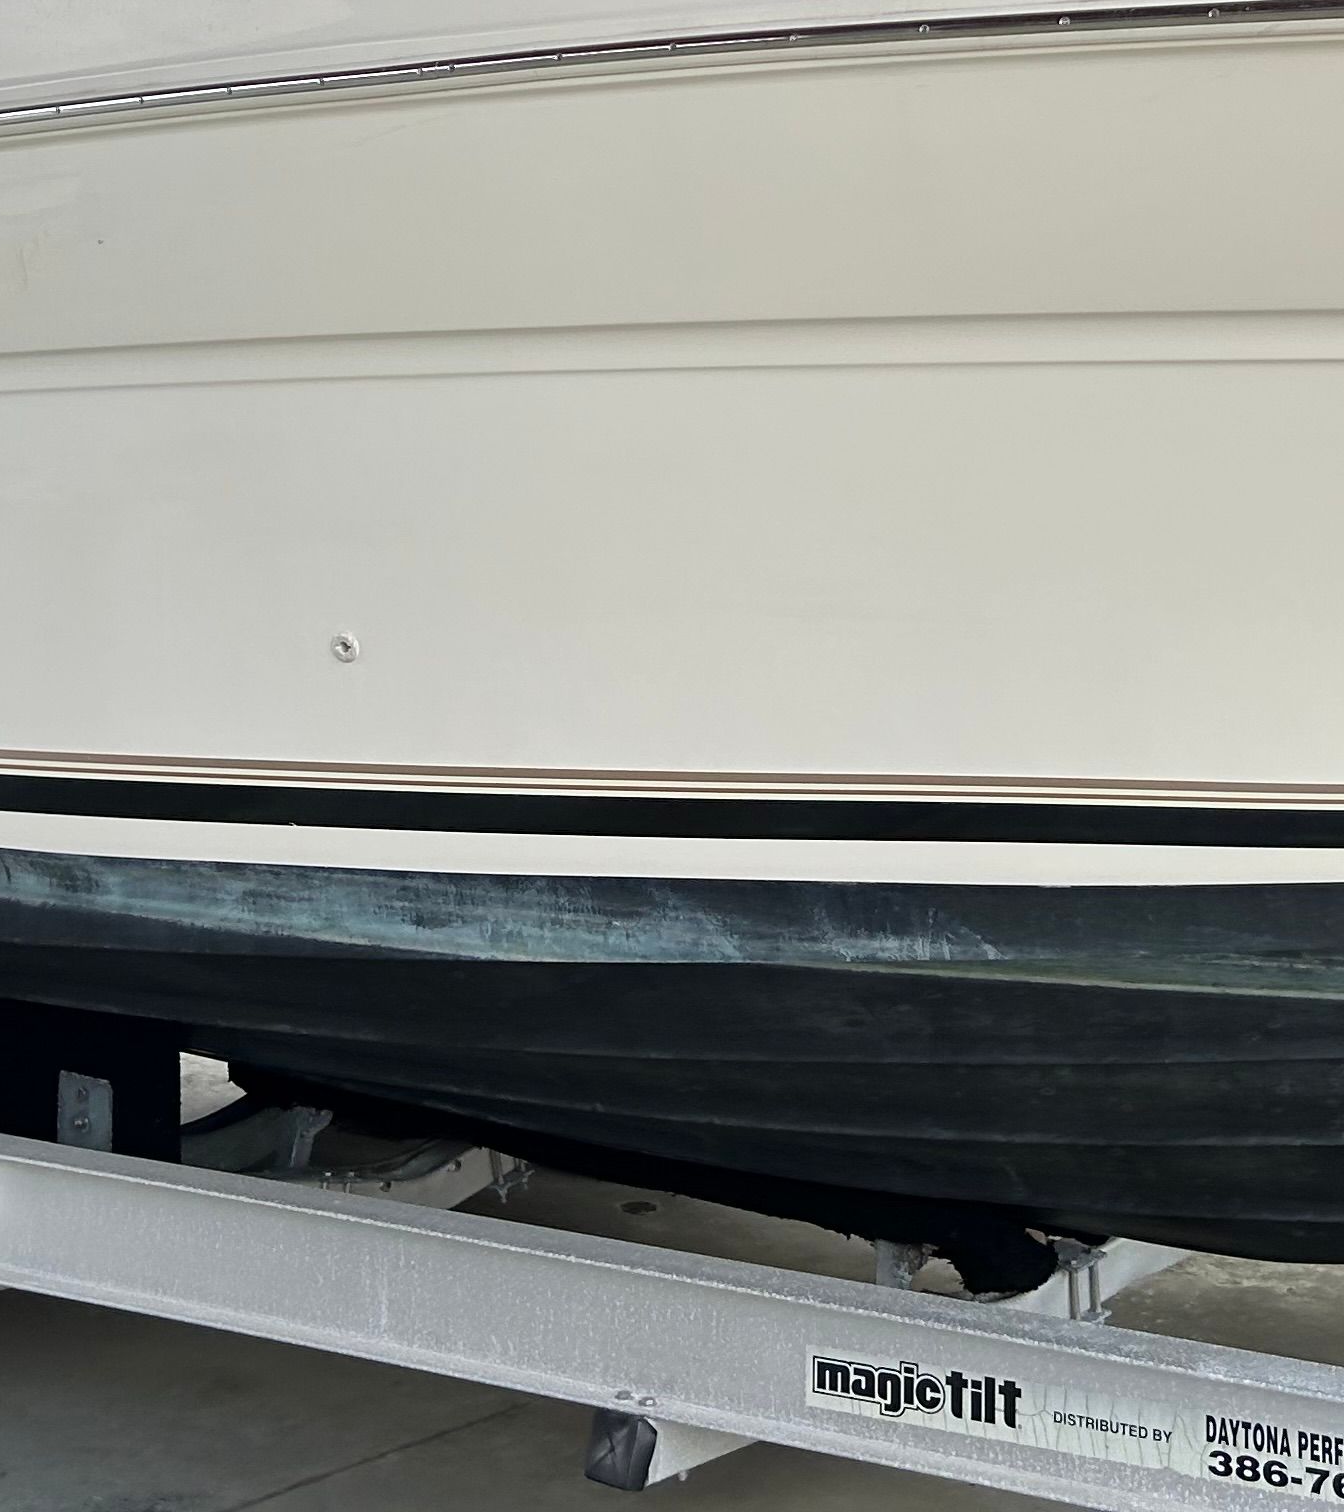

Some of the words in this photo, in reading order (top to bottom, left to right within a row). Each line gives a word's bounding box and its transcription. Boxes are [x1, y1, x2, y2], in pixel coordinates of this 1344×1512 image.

[1052, 1410, 1148, 1439] DISTRIBUTED
[1151, 1428, 1173, 1443] BY
[1205, 1414, 1292, 1457] DAYTONA
